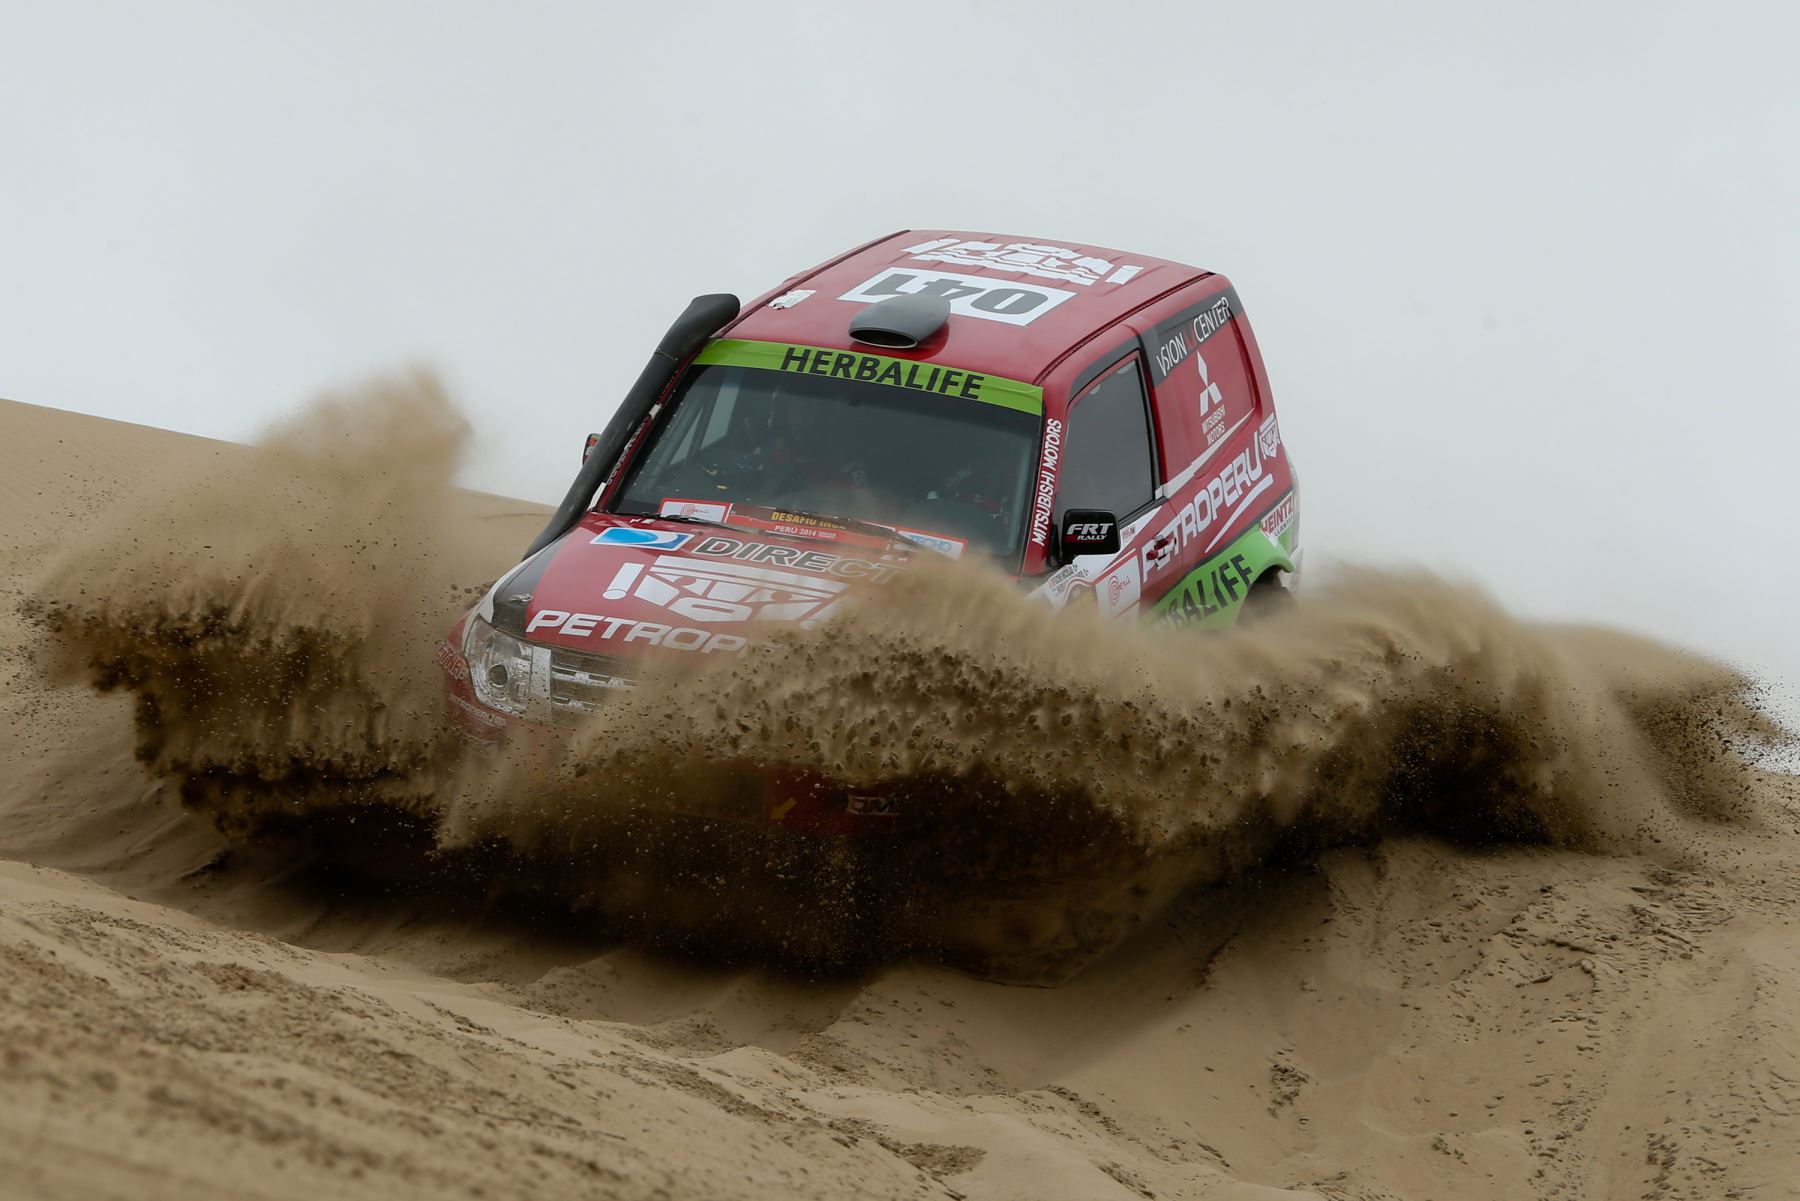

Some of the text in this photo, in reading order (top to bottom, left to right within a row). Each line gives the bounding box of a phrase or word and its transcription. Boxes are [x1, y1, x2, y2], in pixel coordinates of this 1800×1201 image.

[1193, 296, 1231, 342] CENTER
[780, 347, 985, 399] HERBALIFE
[1032, 418, 1062, 547] MITSUBISHI MOTORS
[799, 528, 817, 537] 2014
[1066, 523, 1114, 535] FRT
[1260, 494, 1293, 535] HEINTZ
[692, 536, 914, 585] DIRECT
[525, 609, 749, 661] PETROP
